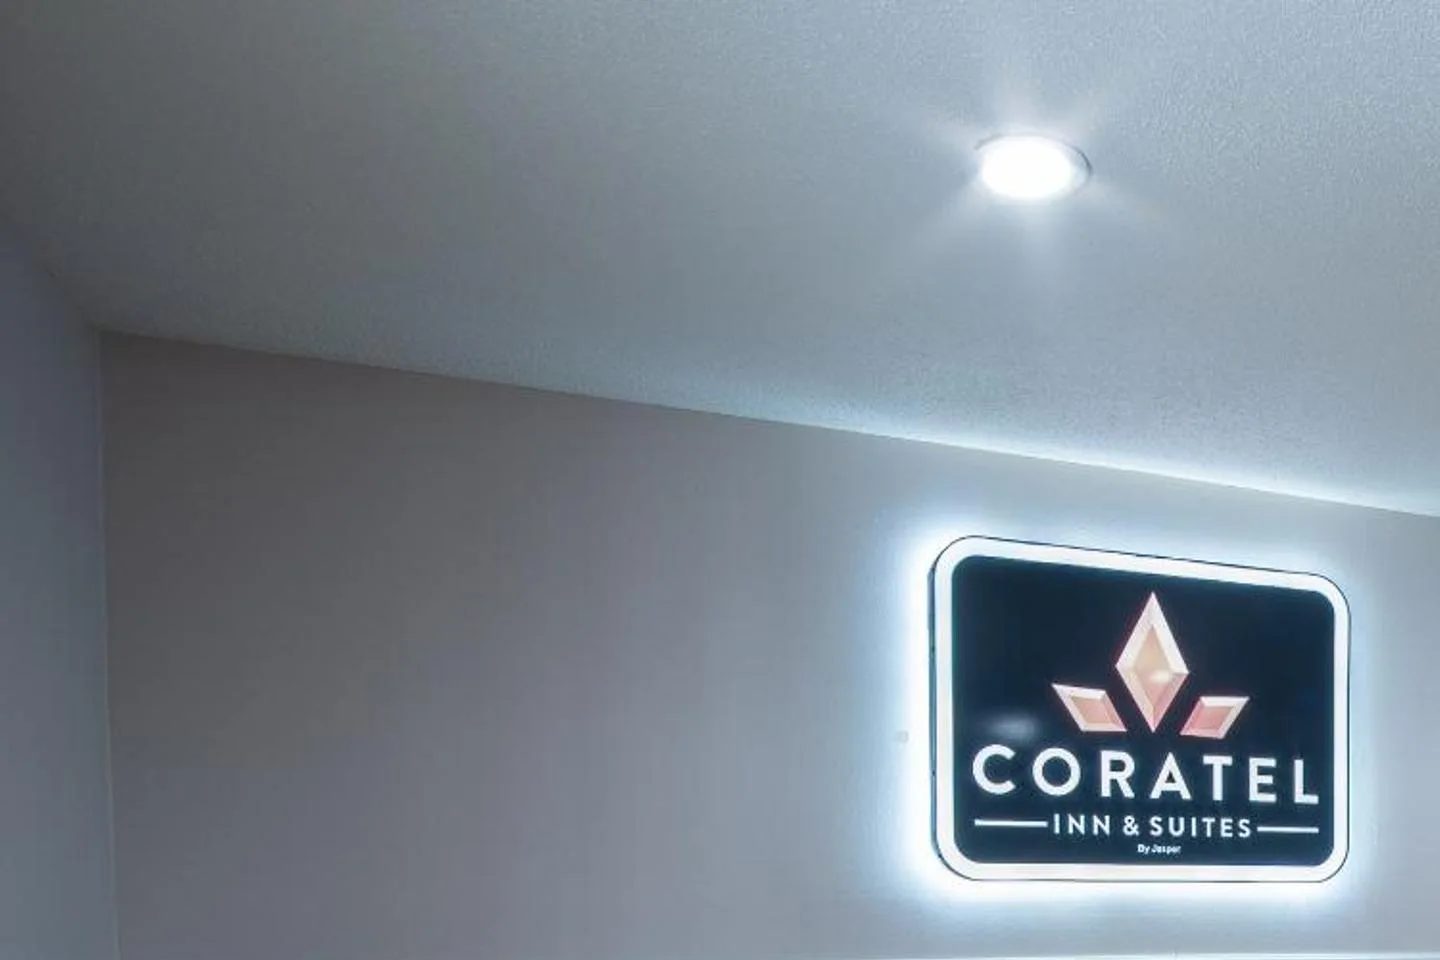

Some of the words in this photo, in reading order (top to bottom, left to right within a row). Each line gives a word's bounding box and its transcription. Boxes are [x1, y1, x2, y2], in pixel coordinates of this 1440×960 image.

[972, 744, 1319, 804] CORATEL
[1054, 813, 1111, 836] INN
[1123, 815, 1140, 837] &
[1149, 815, 1251, 838] SUITES
